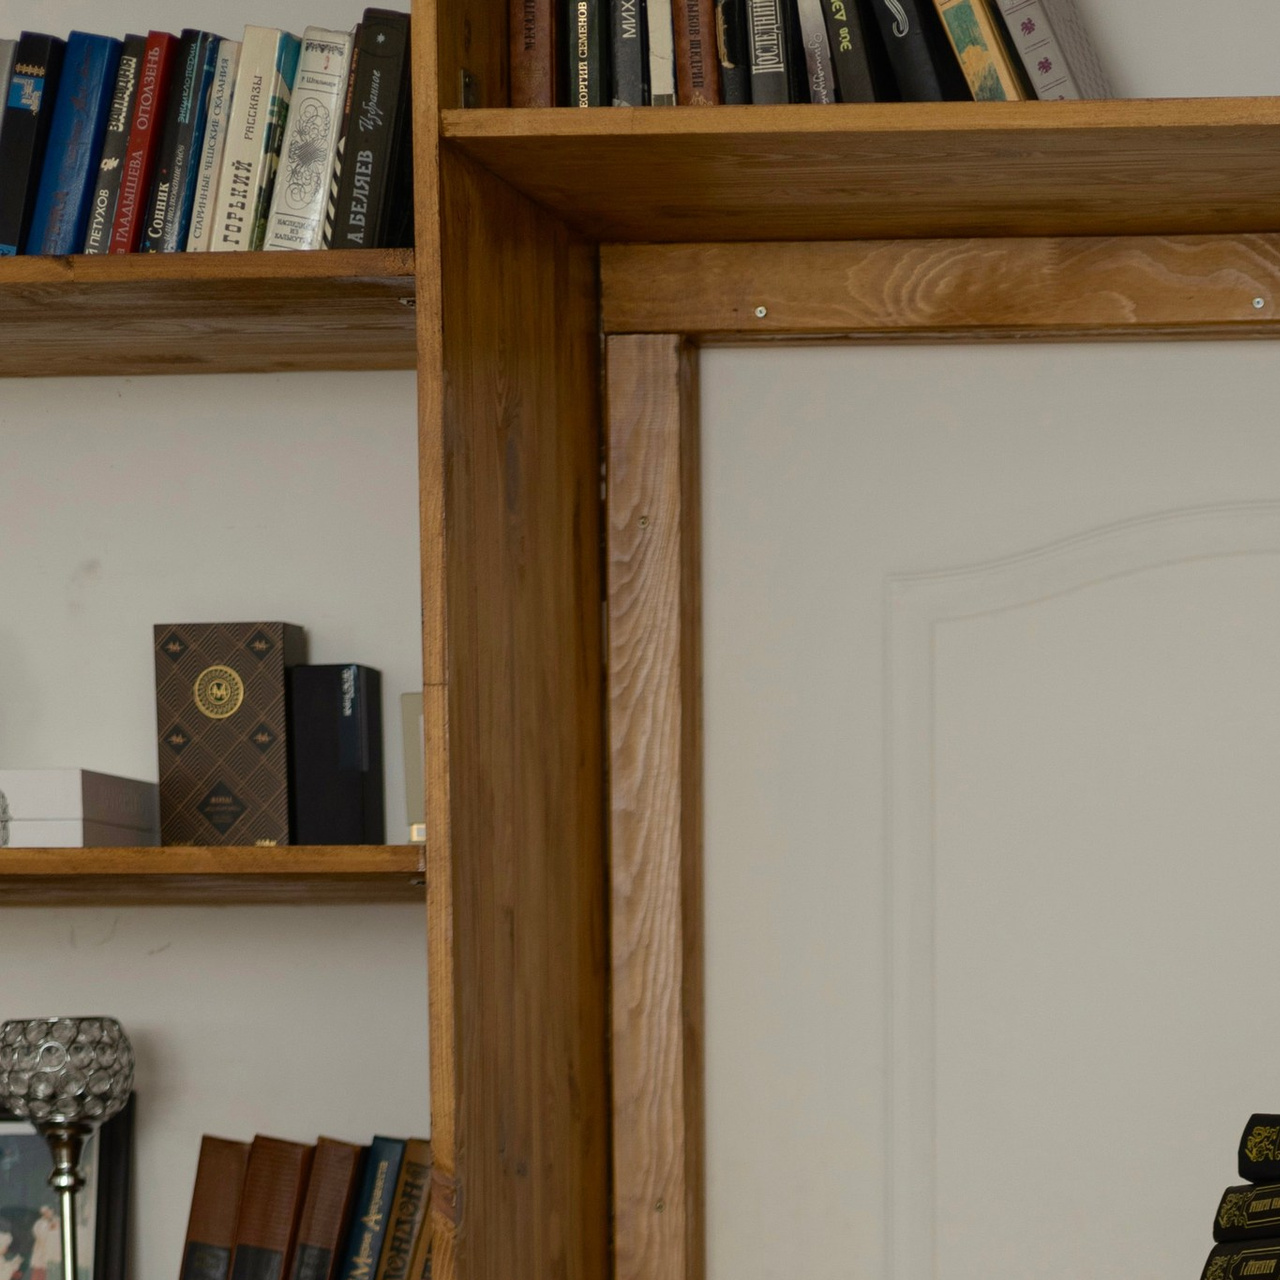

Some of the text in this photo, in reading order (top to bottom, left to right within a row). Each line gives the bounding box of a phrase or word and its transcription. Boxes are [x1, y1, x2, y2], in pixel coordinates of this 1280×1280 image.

[107, 55, 137, 132] ЗАПАДНЯ
[135, 46, 160, 130] ОПОЛЗЕНЬ
[576, 1, 589, 107] ЕОРГИЙ СЕМЕНОВ
[243, 74, 263, 140] РАССКАЗЫ
[357, 68, 388, 133] Избранное
[193, 57, 229, 238] СТАРИННЫЕ ЧЕШСКИЕ СКАЗАНИЯ
[89, 188, 110, 246] ПЕТУХОВ
[115, 148, 143, 242] ГЛАДЫШЕВА
[220, 159, 252, 244] ГОРЬКИЙ
